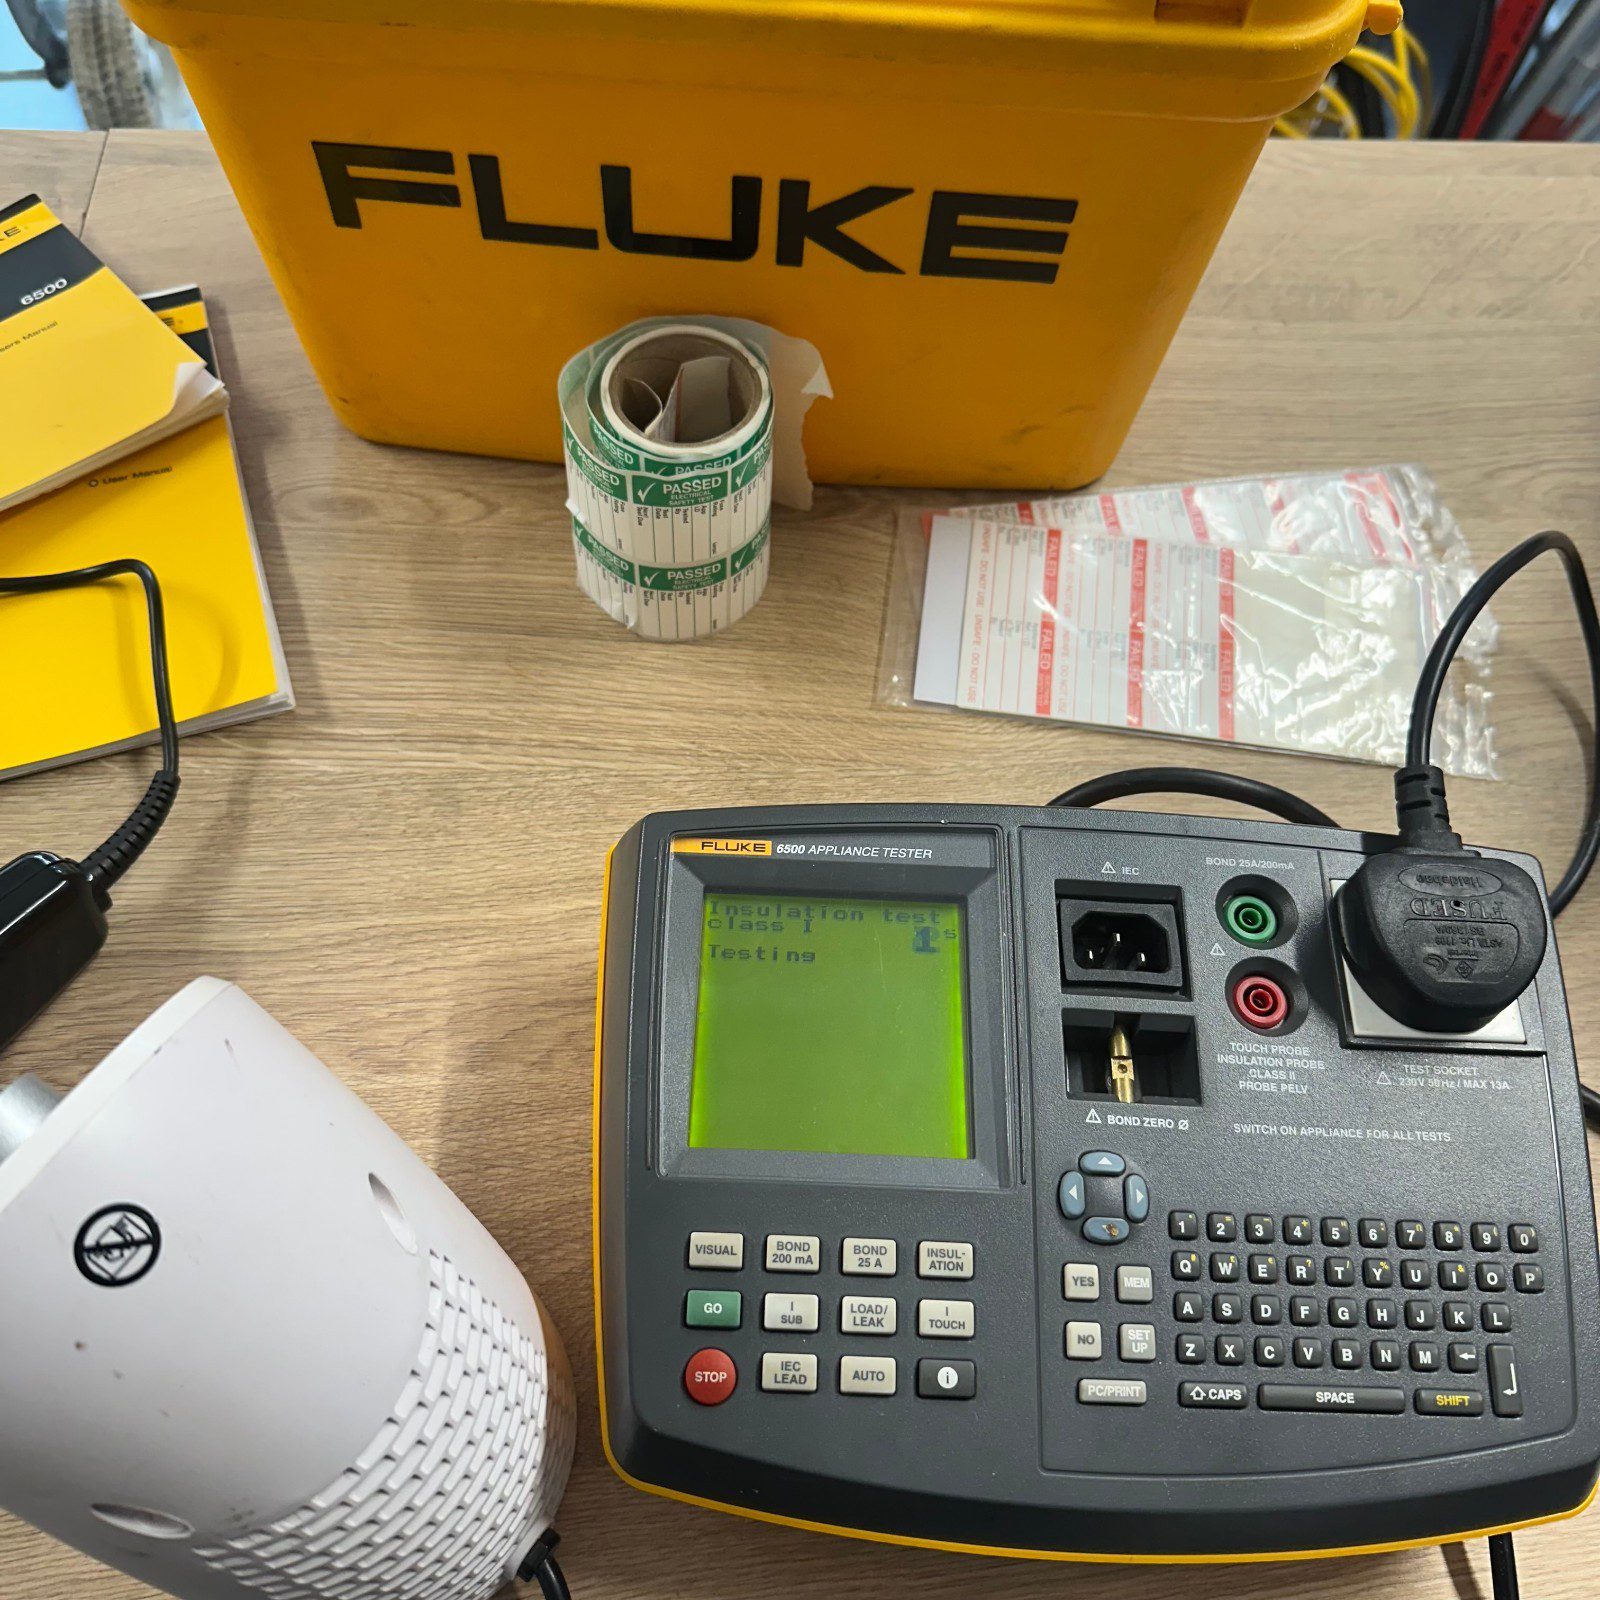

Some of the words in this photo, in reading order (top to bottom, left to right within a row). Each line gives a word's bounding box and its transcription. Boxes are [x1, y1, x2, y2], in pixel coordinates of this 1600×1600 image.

[312, 141, 1079, 284] FLUKE
[21, 278, 67, 305] 6500
[594, 425, 634, 465] PASSED
[577, 446, 620, 486] PASSED
[663, 477, 722, 495] PASSED
[671, 490, 712, 500] ELECTRICAL
[1046, 537, 1059, 576] FAILED
[667, 563, 721, 580] PASSED
[1133, 547, 1144, 587] FAILED
[1041, 629, 1053, 670] FAILED
[1129, 640, 1141, 682] FAILED
[1220, 651, 1231, 692] FAILED
[701, 841, 766, 853] FLUKE
[776, 843, 806, 855] 6500
[808, 845, 879, 857] APPLIANCE
[882, 848, 932, 859] TESTER
[1205, 857, 1237, 867] BOND
[1239, 860, 1296, 870] 25A/200mA
[1122, 866, 1140, 876] IEC
[710, 901, 864, 920] Insulation
[883, 909, 940, 924] test
[1410, 900, 1507, 921] FUSED
[709, 944, 815, 961] Testing
[1229, 1042, 1268, 1053] TOUCH
[1271, 1045, 1311, 1056] PROBE
[1217, 1053, 1283, 1067] INSULATION
[1286, 1058, 1325, 1070] PROBE
[1249, 1068, 1286, 1080] CLASS
[1403, 1064, 1430, 1074] TEST
[1433, 1065, 1478, 1076] SOCKET
[1239, 1080, 1278, 1092] PROBE
[1281, 1083, 1308, 1094] PELV
[1398, 1078, 1425, 1087] 230V
[1463, 1079, 1488, 1089] MAX
[1490, 1080, 1510, 1090] 13A
[1107, 1114, 1141, 1126] BOND
[1143, 1117, 1174, 1129] ZERO
[1233, 1123, 1277, 1135] SWITCH
[1280, 1125, 1297, 1135] ON
[1300, 1127, 1363, 1138] APPLIANCE
[1366, 1129, 1389, 1139] FOR
[1179, 1221, 1184, 1233] 1
[1217, 1223, 1225, 1235] 2
[1255, 1224, 1263, 1236] 3
[1294, 1226, 1302, 1238] 4
[1332, 1227, 1340, 1239] 5
[1369, 1229, 1377, 1241] 6
[1407, 1230, 1415, 1242] 7
[1445, 1231, 1454, 1243] 8
[1483, 1232, 1491, 1244] 9
[695, 1244, 738, 1256] VISUAL
[776, 1241, 811, 1252] BOND
[853, 1245, 888, 1256] BOND
[772, 1253, 793, 1264] 200
[795, 1254, 813, 1265] mA
[926, 1248, 966, 1259] INSUL-
[858, 1257, 873, 1268] 25
[874, 1258, 883, 1268] A
[929, 1260, 964, 1272] ATION
[1180, 1260, 1191, 1273] Q
[1218, 1262, 1232, 1275] W
[1258, 1264, 1267, 1277] E
[1296, 1265, 1306, 1278] R
[1334, 1267, 1344, 1279] T
[1372, 1268, 1382, 1281] Y
[1410, 1268, 1421, 1282] U
[1072, 1276, 1095, 1287] YES
[1124, 1277, 1149, 1288] MEM
[1525, 1273, 1535, 1285] P
[703, 1303, 723, 1314] GO
[850, 1303, 889, 1315] LOAD/
[1183, 1301, 1193, 1314] A
[1222, 1303, 1232, 1316] S
[1261, 1304, 1271, 1317] D
[1300, 1306, 1309, 1318] F
[1338, 1307, 1349, 1320] G
[780, 1314, 803, 1325] SUB
[1377, 1308, 1387, 1321] H
[1417, 1310, 1424, 1323] J
[1454, 1311, 1465, 1324] K
[1493, 1312, 1502, 1325] L
[853, 1316, 885, 1327] LEAK
[929, 1319, 966, 1330] TOUCH
[1077, 1334, 1095, 1345] NO
[1128, 1329, 1150, 1341] SET
[1132, 1342, 1148, 1353] UP
[1186, 1343, 1195, 1356] Z
[1224, 1344, 1235, 1357] X
[1264, 1346, 1275, 1359] C
[1303, 1347, 1313, 1360] V
[1342, 1348, 1352, 1361] B
[1379, 1348, 1391, 1362] N
[1419, 1351, 1431, 1364] M
[780, 1361, 800, 1372] IEC
[694, 1371, 727, 1383] STOP
[774, 1375, 807, 1385] LEAD
[852, 1370, 885, 1382] AUTO
[1087, 1385, 1141, 1398] PC/PRINT
[1209, 1389, 1242, 1400] CAPS
[1316, 1392, 1355, 1403] SPACE
[1436, 1395, 1470, 1406] SHIFT
